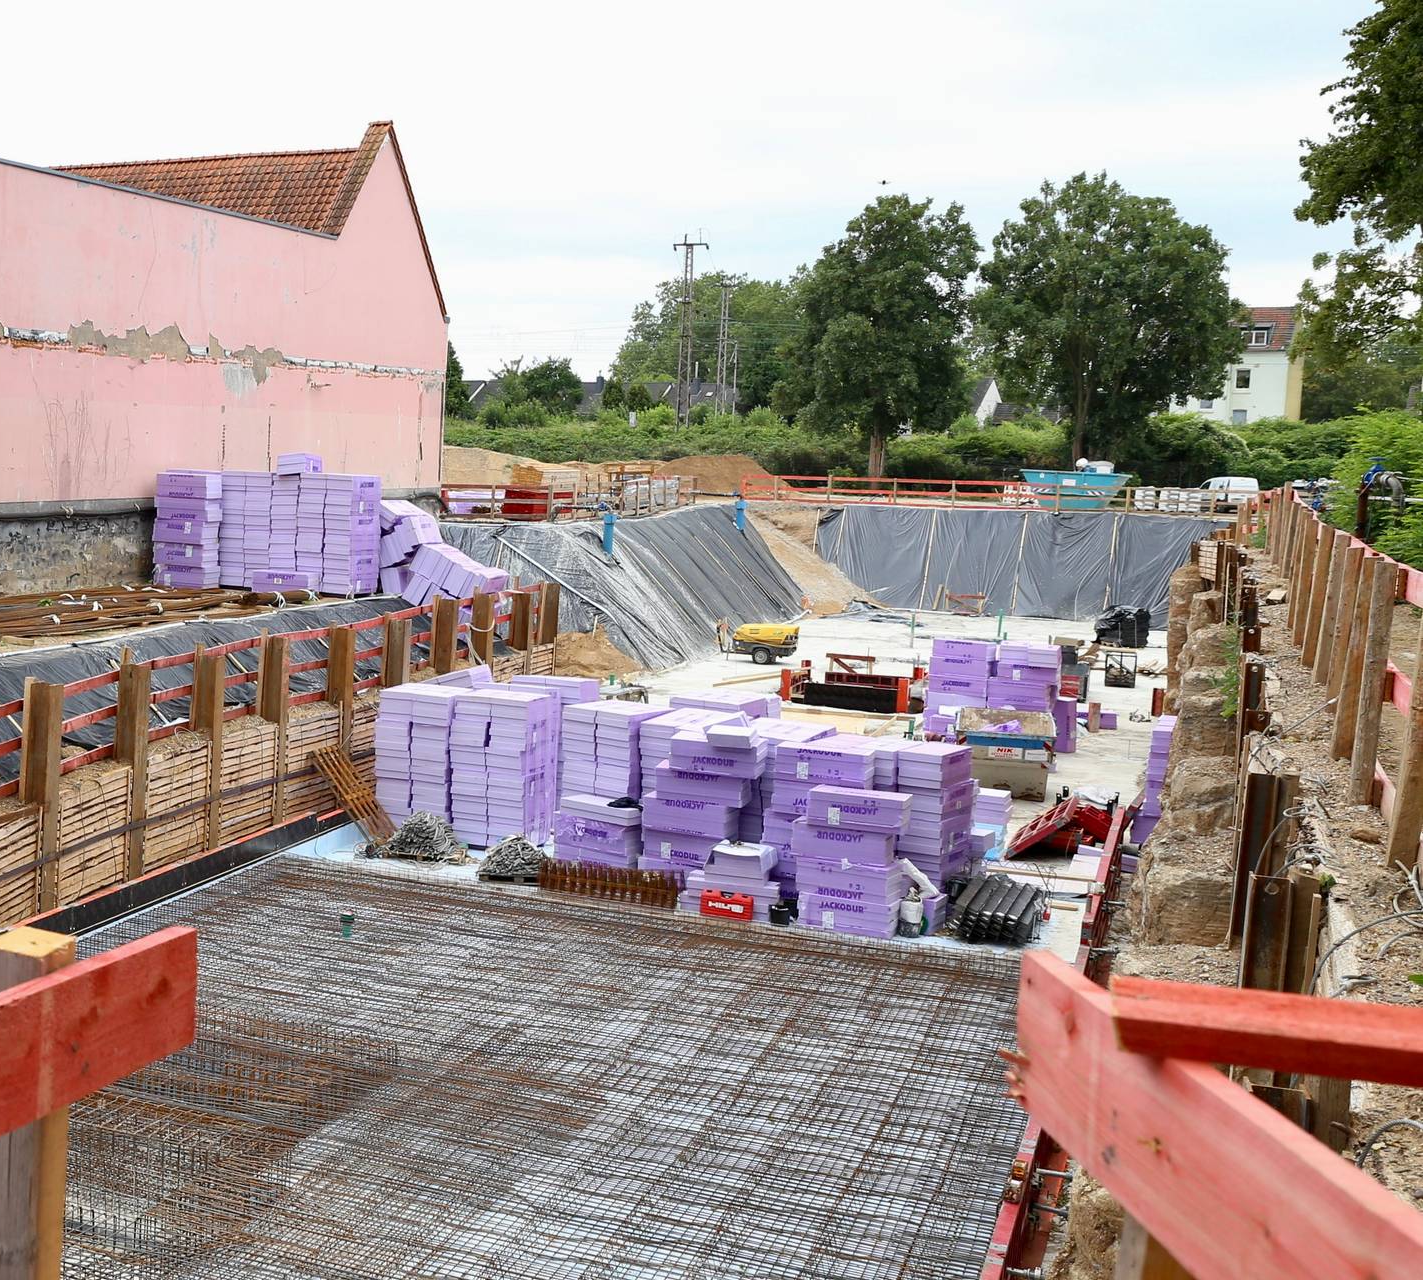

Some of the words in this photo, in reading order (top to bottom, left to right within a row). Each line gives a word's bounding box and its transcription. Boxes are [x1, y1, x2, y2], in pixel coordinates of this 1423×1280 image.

[817, 830, 864, 843] JACKODUR
[670, 849, 699, 861] CKODUR
[818, 887, 864, 900] JACKODUR
[819, 901, 864, 914] JACKODUR
